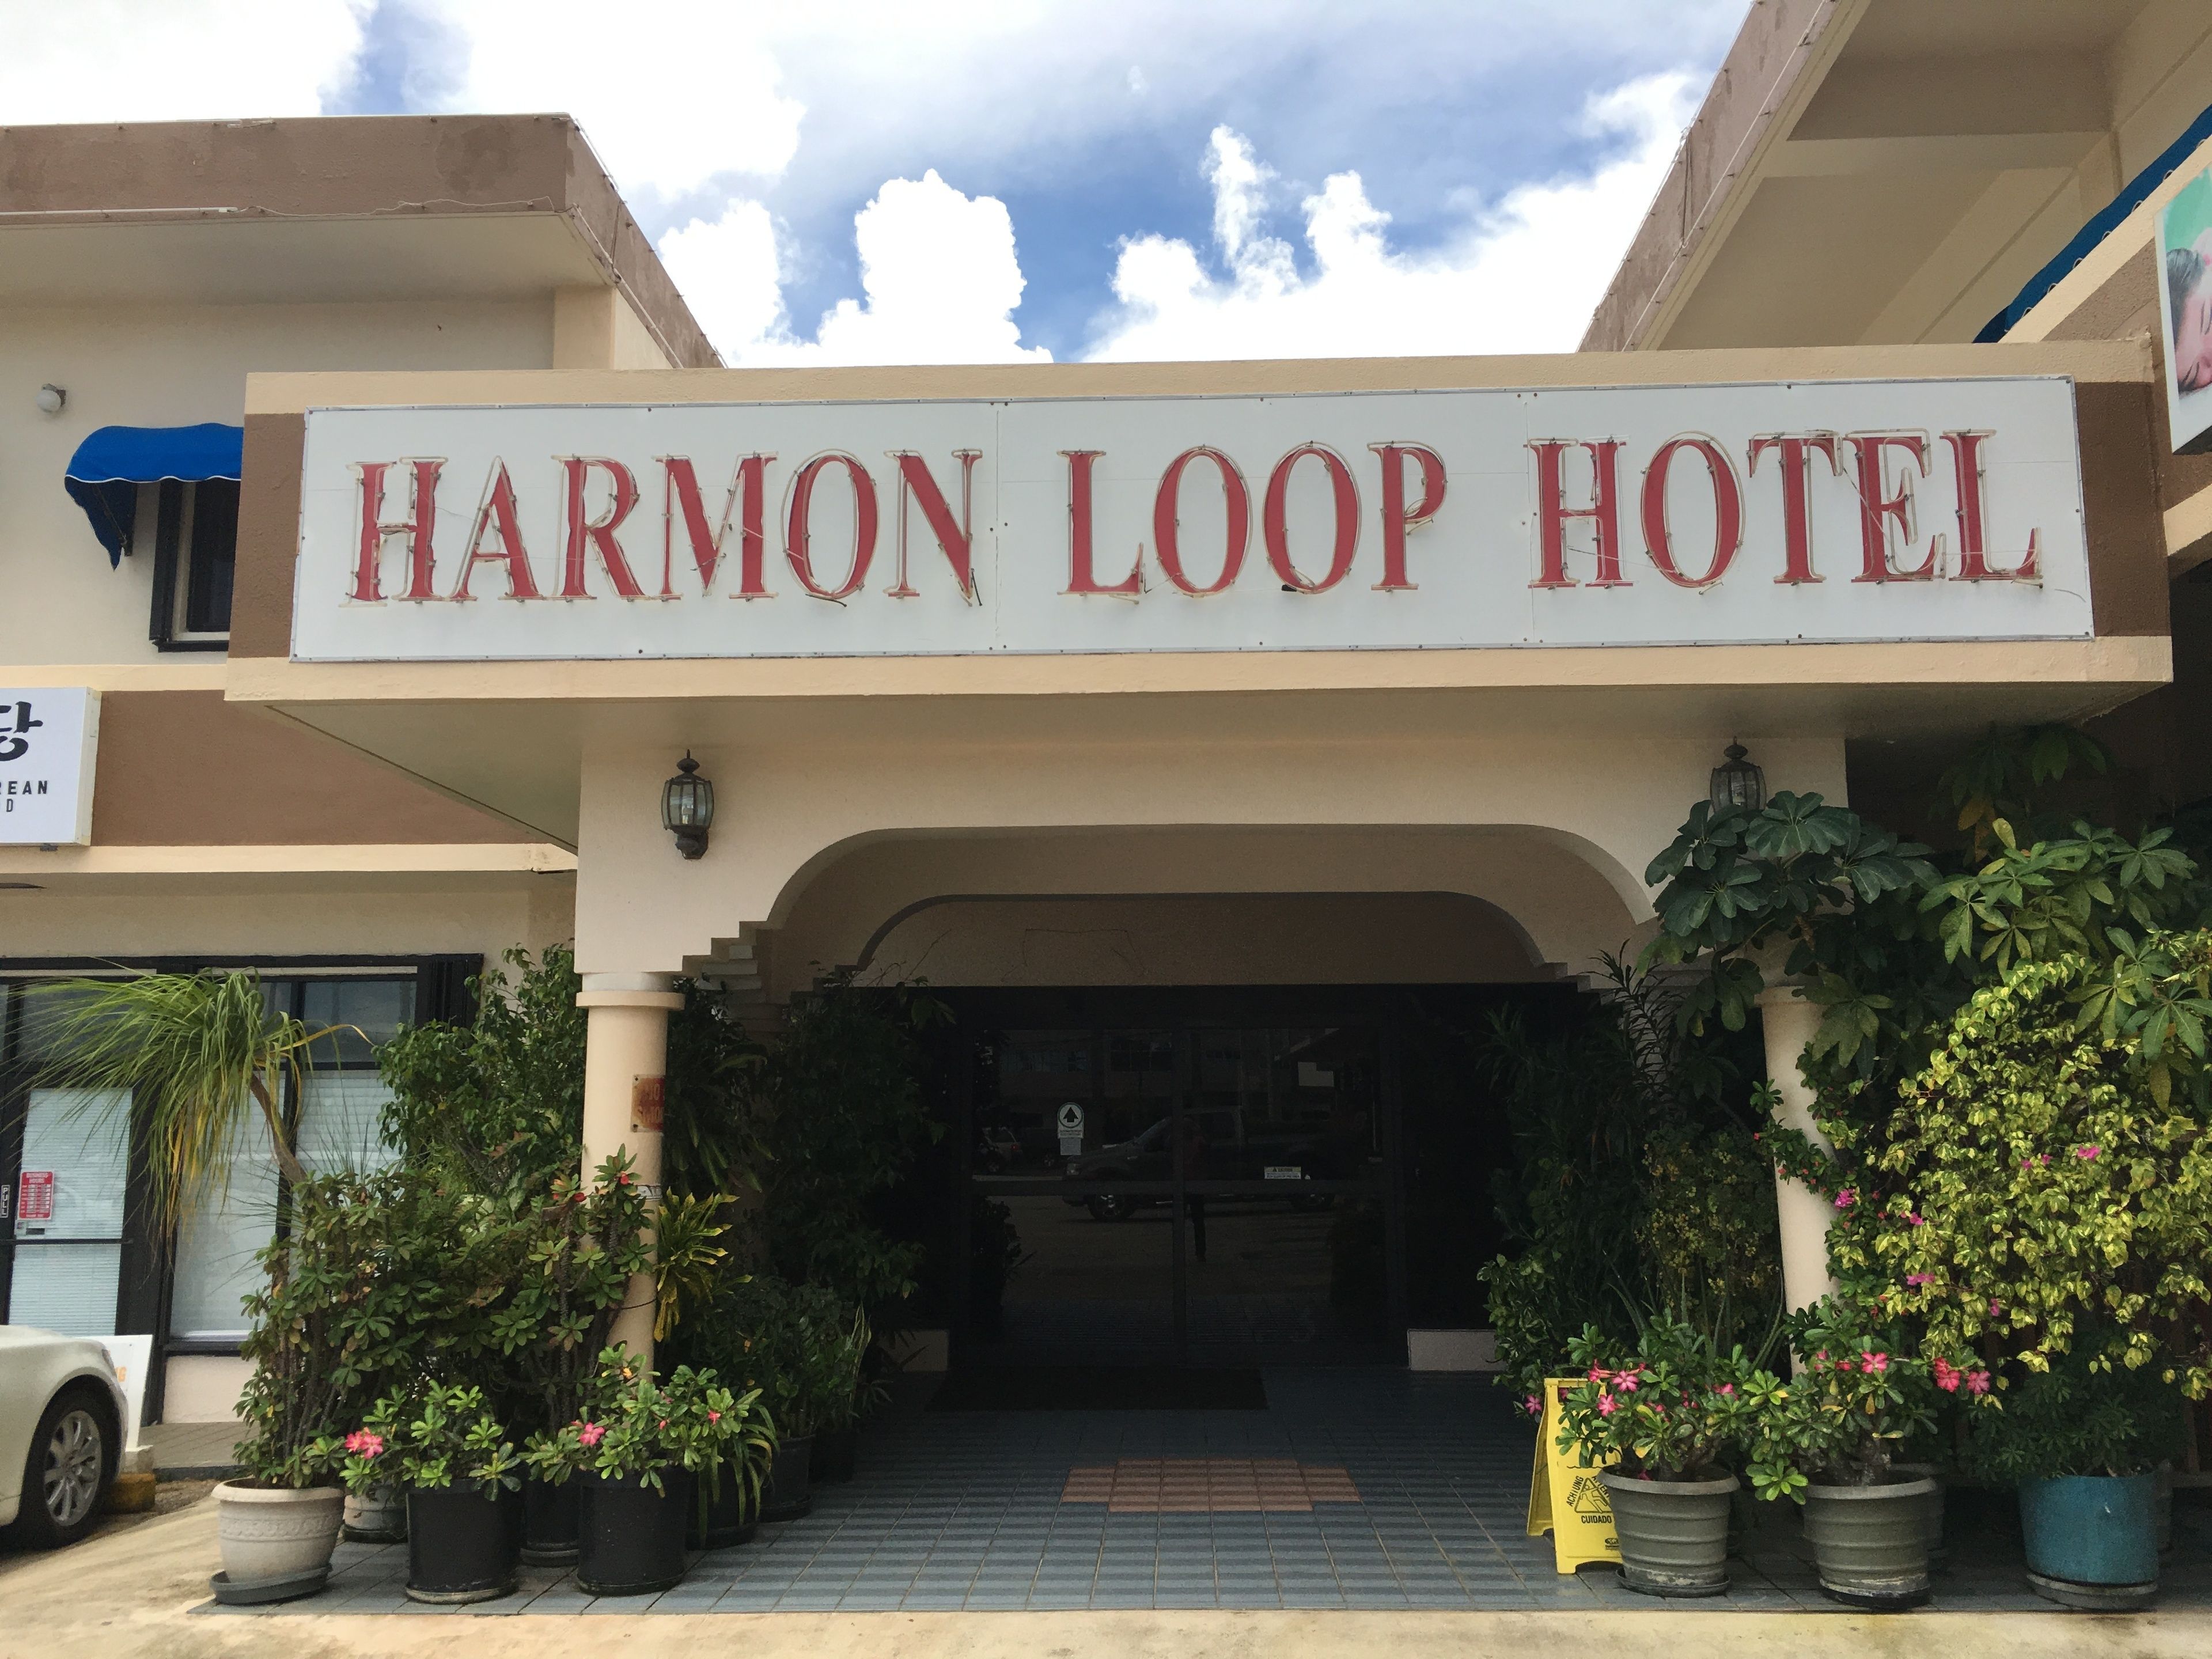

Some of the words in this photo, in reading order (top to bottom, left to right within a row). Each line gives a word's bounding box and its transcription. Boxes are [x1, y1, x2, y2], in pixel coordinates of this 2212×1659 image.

[340, 448, 982, 605] HARMON
[1057, 442, 1447, 597] LOOP
[1524, 429, 2043, 589] HOTEL
[0, 781, 47, 794] EAN
[1566, 1476, 1584, 1507] ACHTUNG
[1581, 1516, 1612, 1524] CUIDADO
